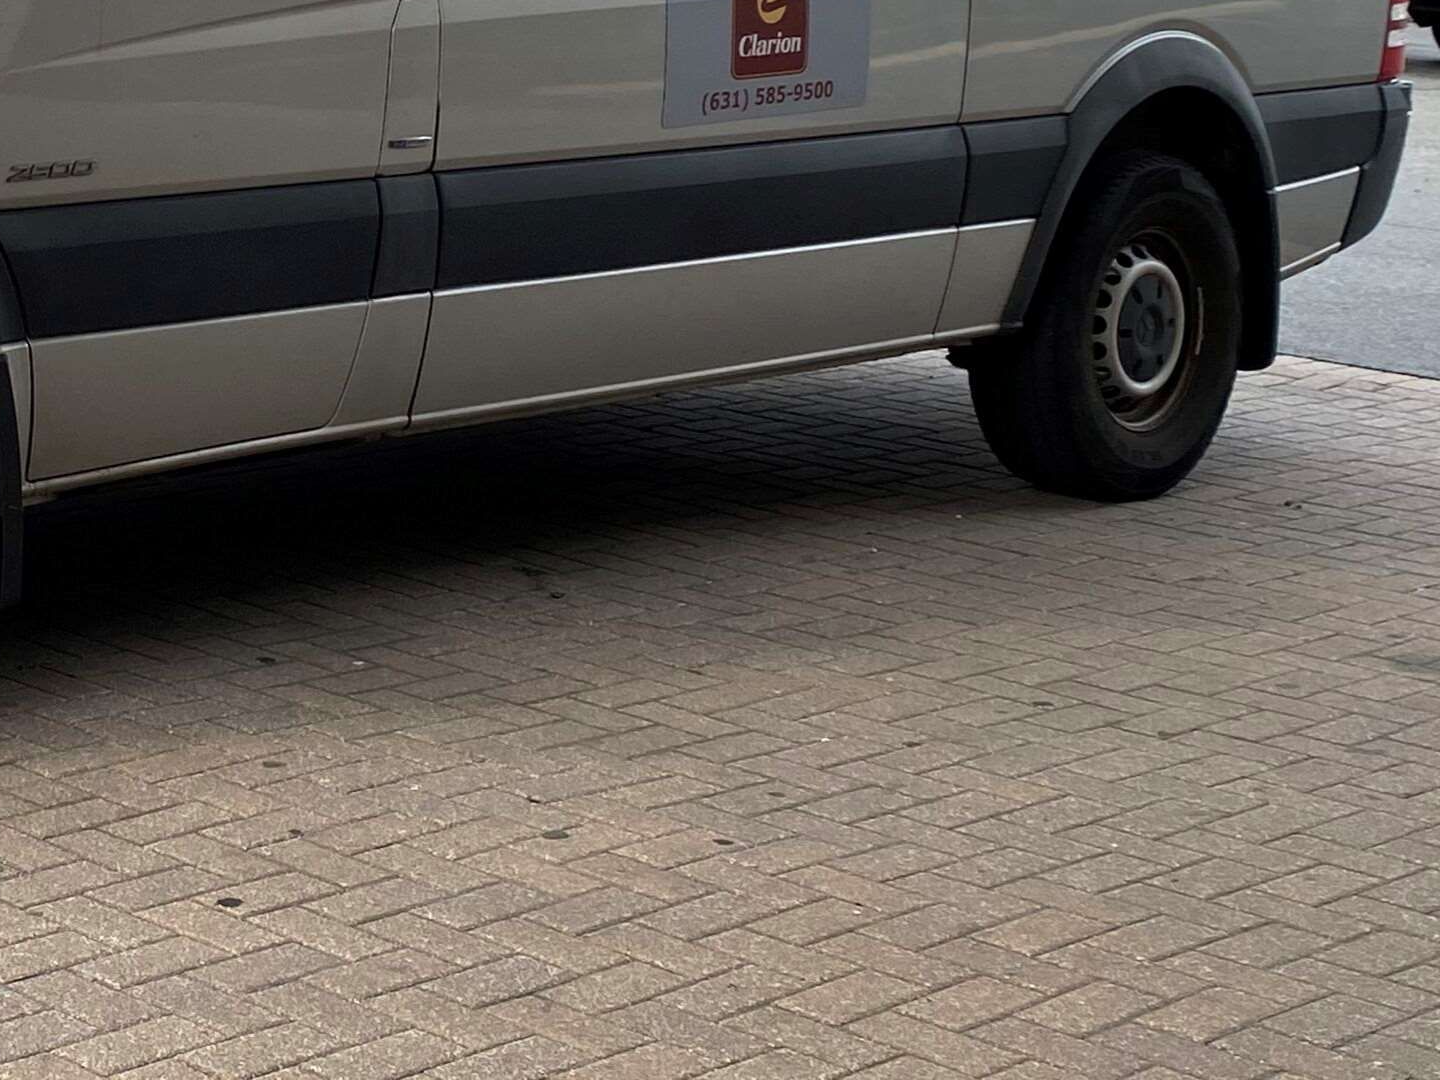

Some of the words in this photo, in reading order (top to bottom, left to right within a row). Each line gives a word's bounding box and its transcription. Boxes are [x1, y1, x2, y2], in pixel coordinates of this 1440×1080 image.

[738, 31, 802, 58] Clarion
[701, 88, 750, 115] (631)
[754, 80, 834, 106] 585-9500
[6, 160, 97, 183] 2500
